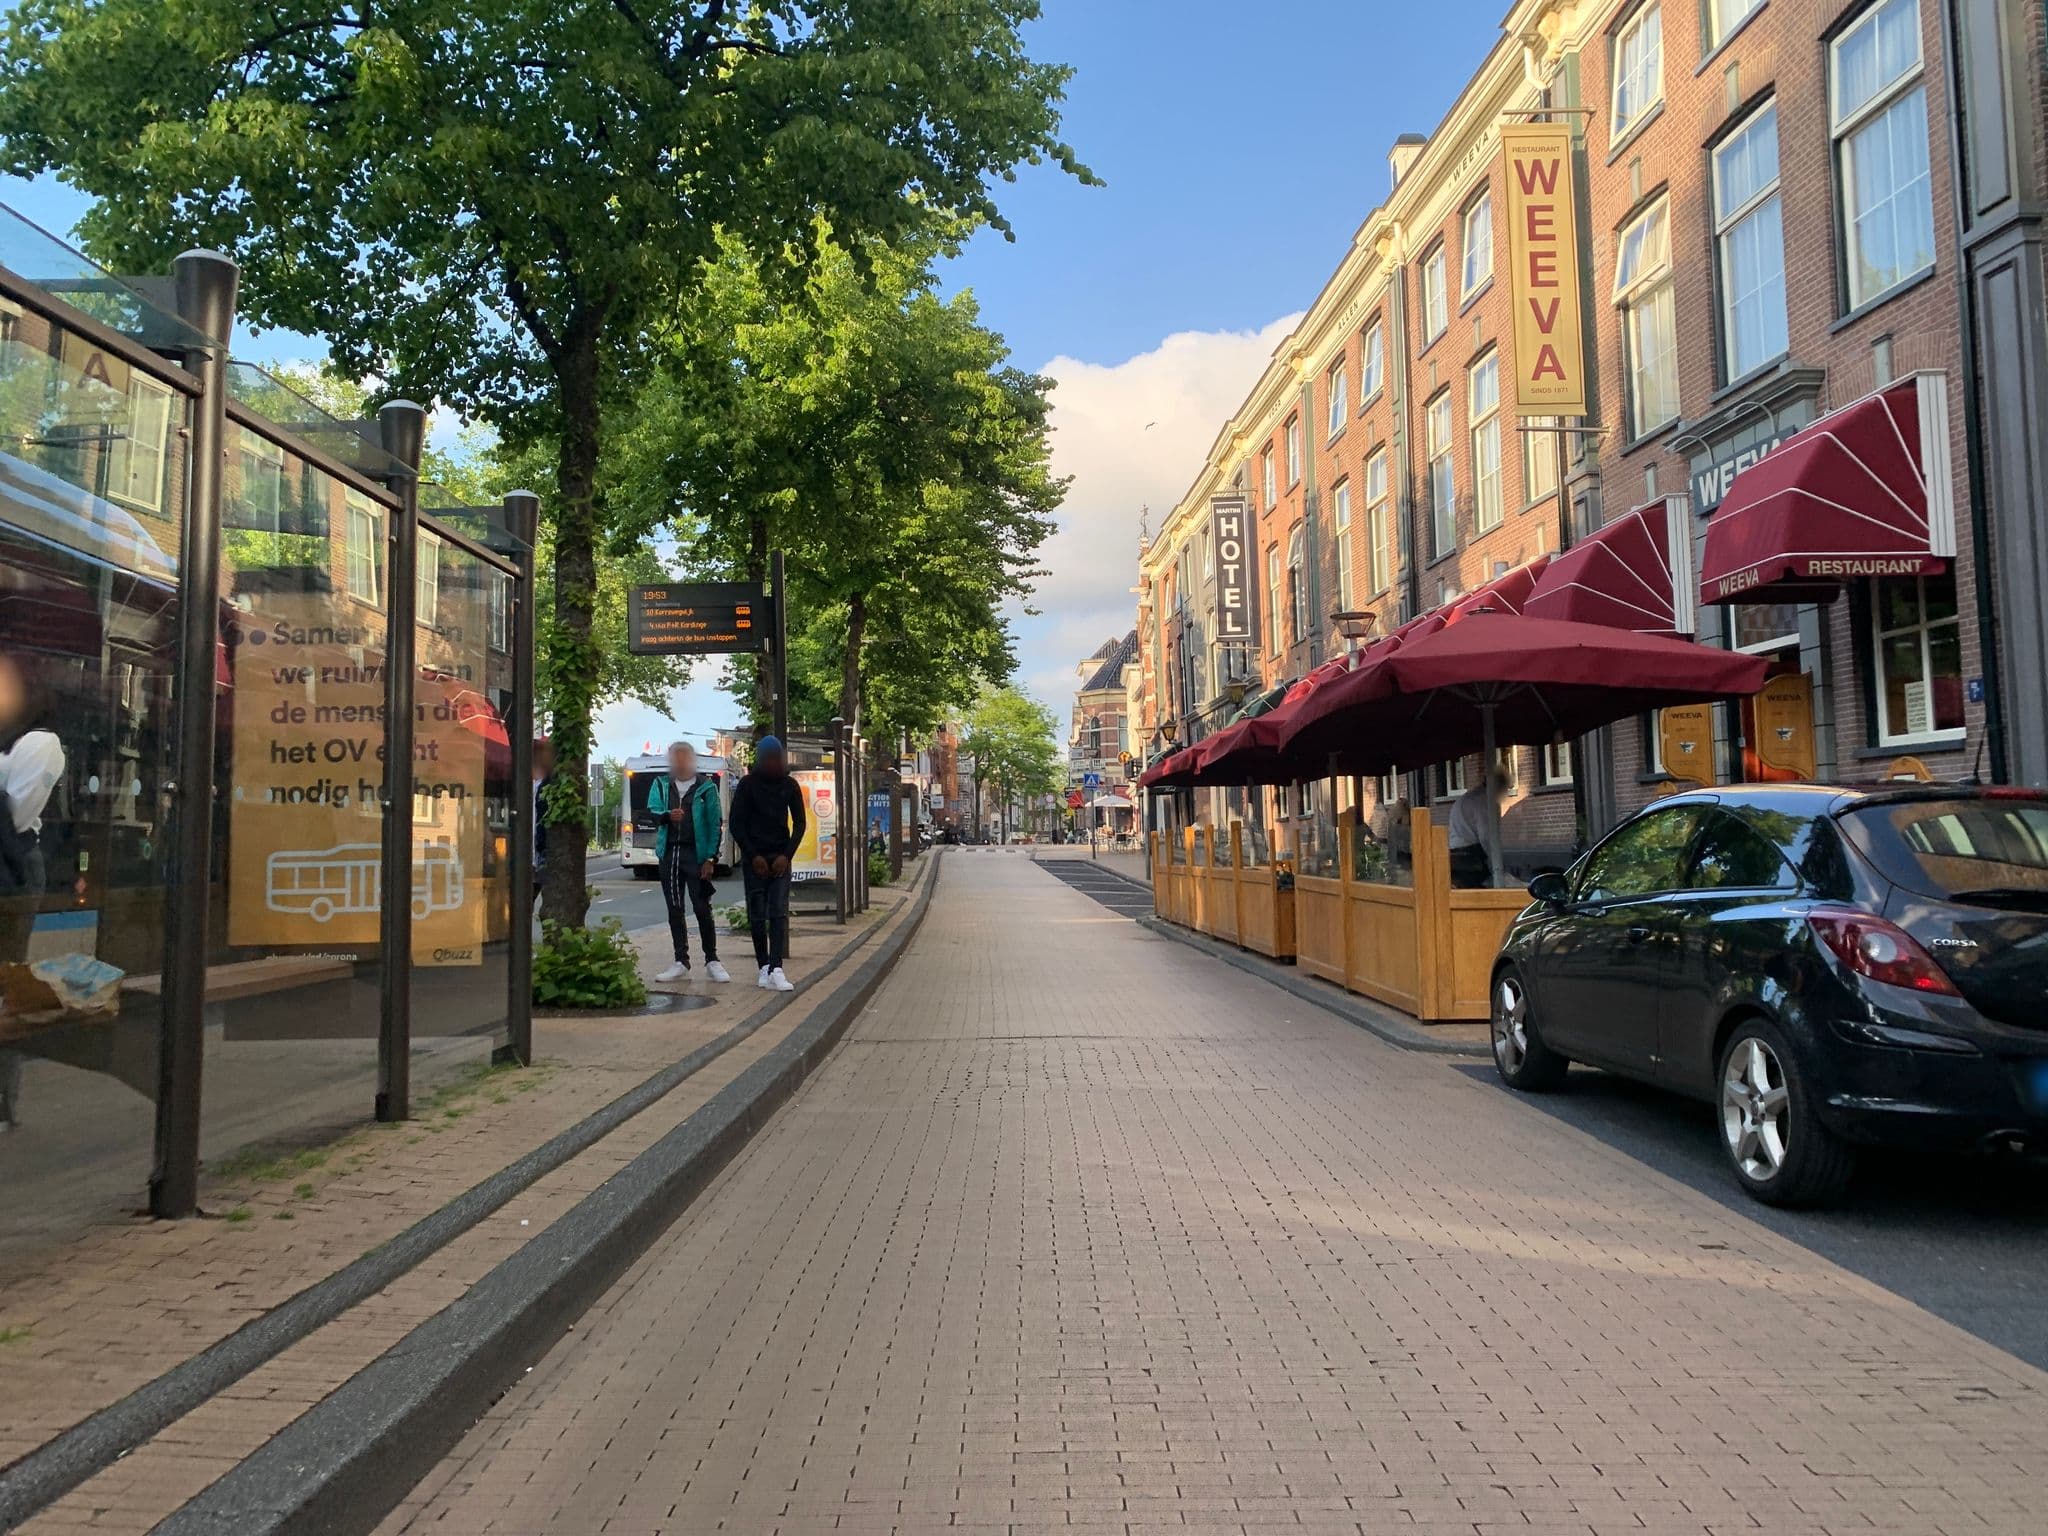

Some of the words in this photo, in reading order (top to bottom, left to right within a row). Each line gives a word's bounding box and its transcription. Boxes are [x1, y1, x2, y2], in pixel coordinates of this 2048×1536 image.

[1511, 145, 1560, 153] RESTAURANT
[1513, 158, 1566, 381] WEEVA
[1220, 516, 1242, 632] HOTEL
[1808, 559, 1924, 575] RESTAURANT
[1718, 568, 1760, 597] WEEVA
[644, 591, 666, 599] 19:53
[1767, 693, 1802, 703] WEEVA
[270, 701, 306, 724] de
[1671, 711, 1703, 719] WEEVA
[271, 740, 316, 764] het
[323, 739, 367, 763] OV
[270, 779, 349, 808] nodig
[1932, 938, 1979, 947] CORSA
[432, 948, 473, 962] Qbuzz
